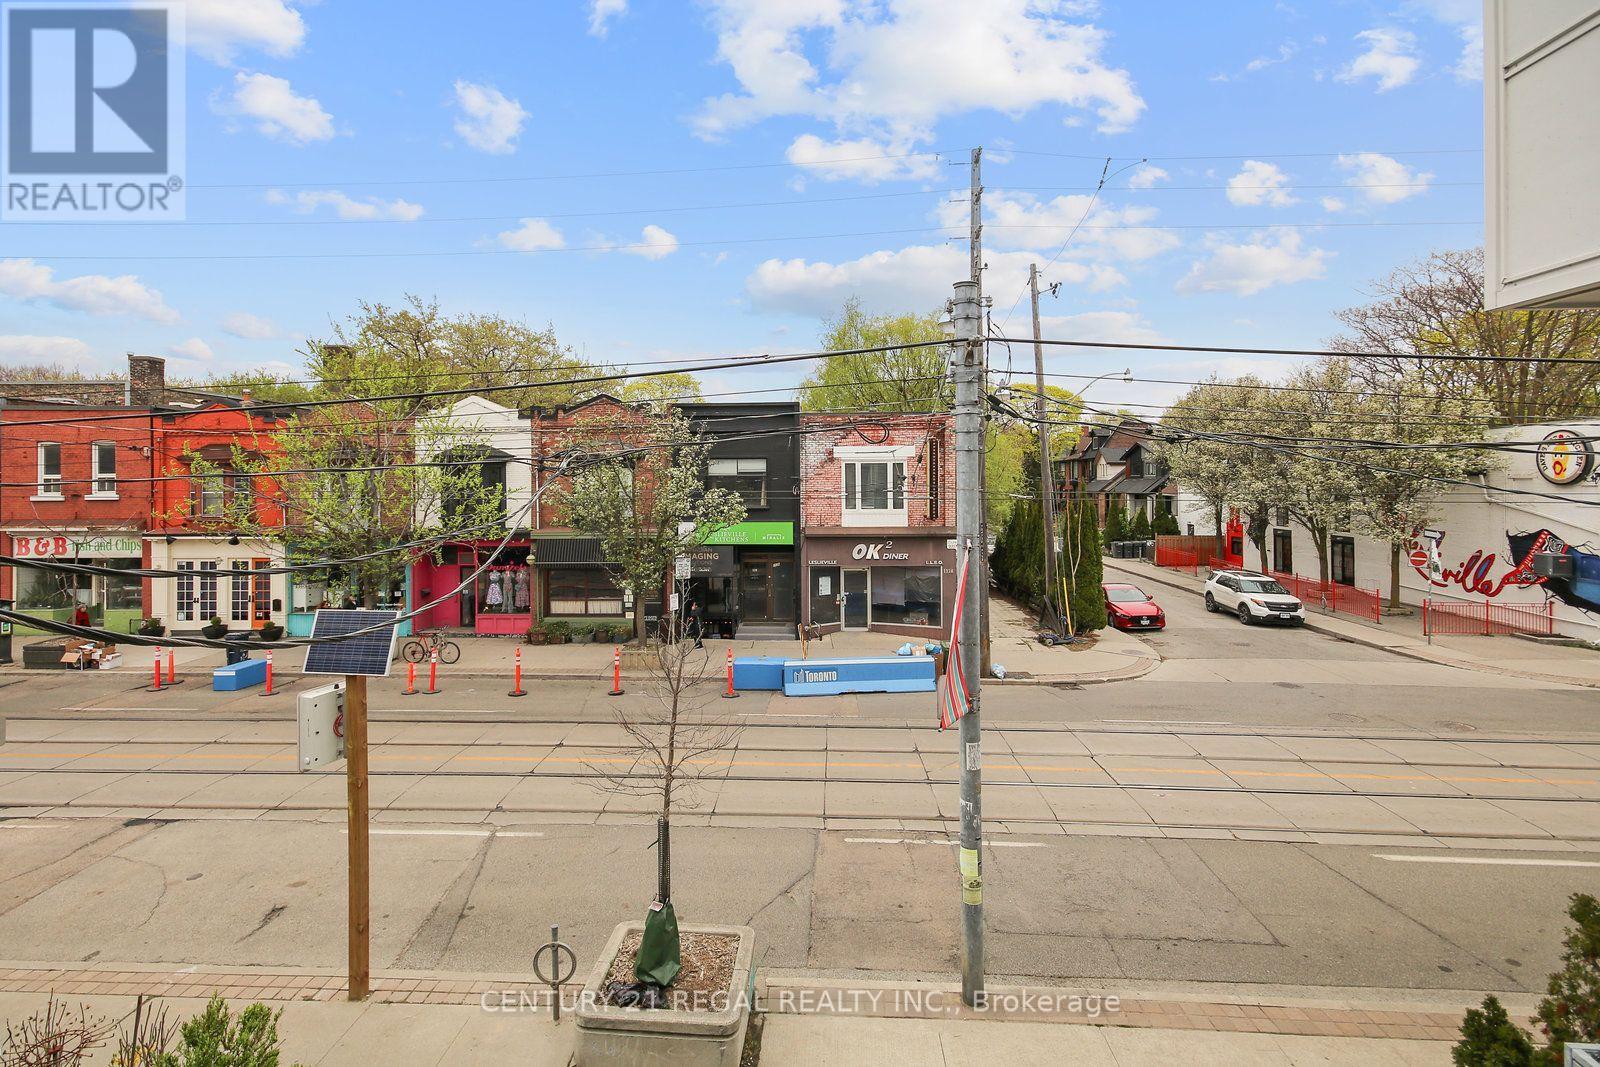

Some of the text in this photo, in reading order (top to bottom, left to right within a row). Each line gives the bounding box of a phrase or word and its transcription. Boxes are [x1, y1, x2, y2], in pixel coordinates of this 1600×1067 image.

[95, 540, 111, 551] and
[115, 540, 141, 554] Chips
[684, 552, 719, 560] MAGING
[805, 670, 837, 682] TORONTO
